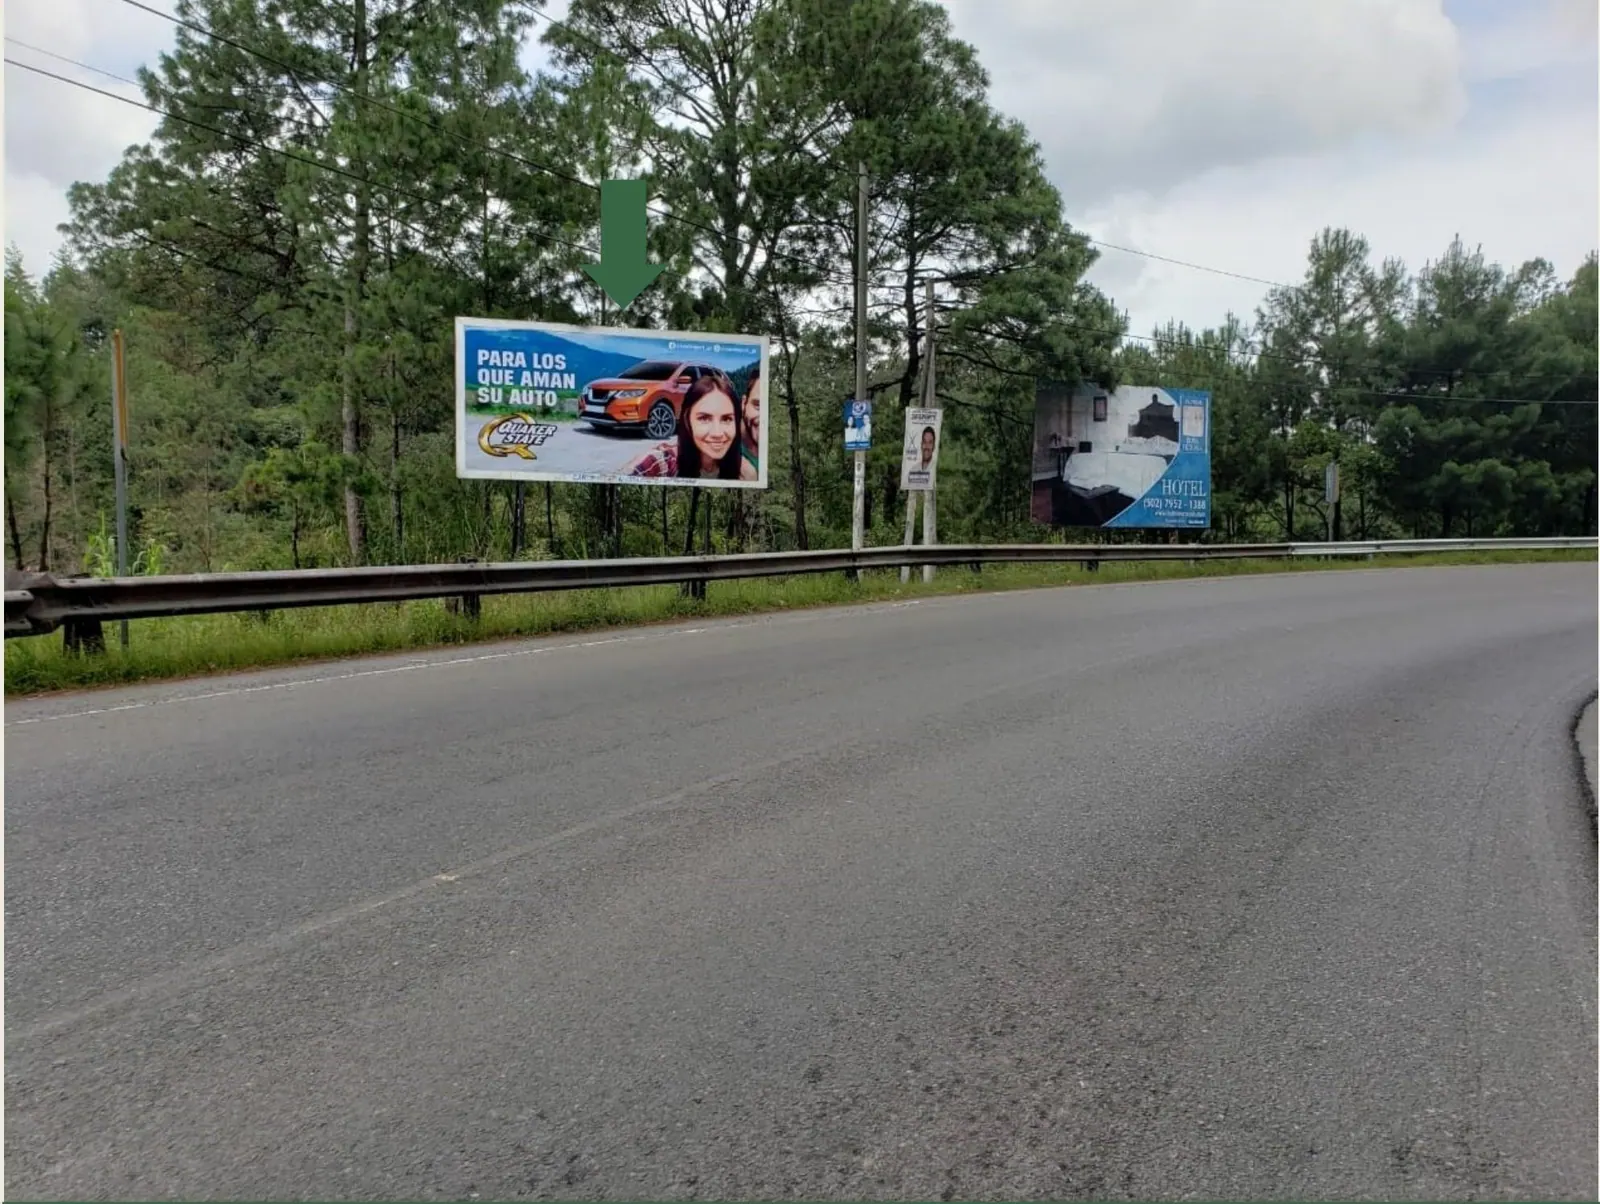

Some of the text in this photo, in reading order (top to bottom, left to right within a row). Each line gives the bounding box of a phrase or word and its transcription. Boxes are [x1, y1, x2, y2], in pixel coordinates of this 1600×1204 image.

[477, 349, 566, 370] PARA LOS
[478, 368, 576, 389] QUE AMAN
[477, 387, 558, 407] SU AUTO
[498, 421, 557, 437] QUAKER
[503, 434, 546, 446] STATE
[1162, 479, 1208, 496] HOTEL
